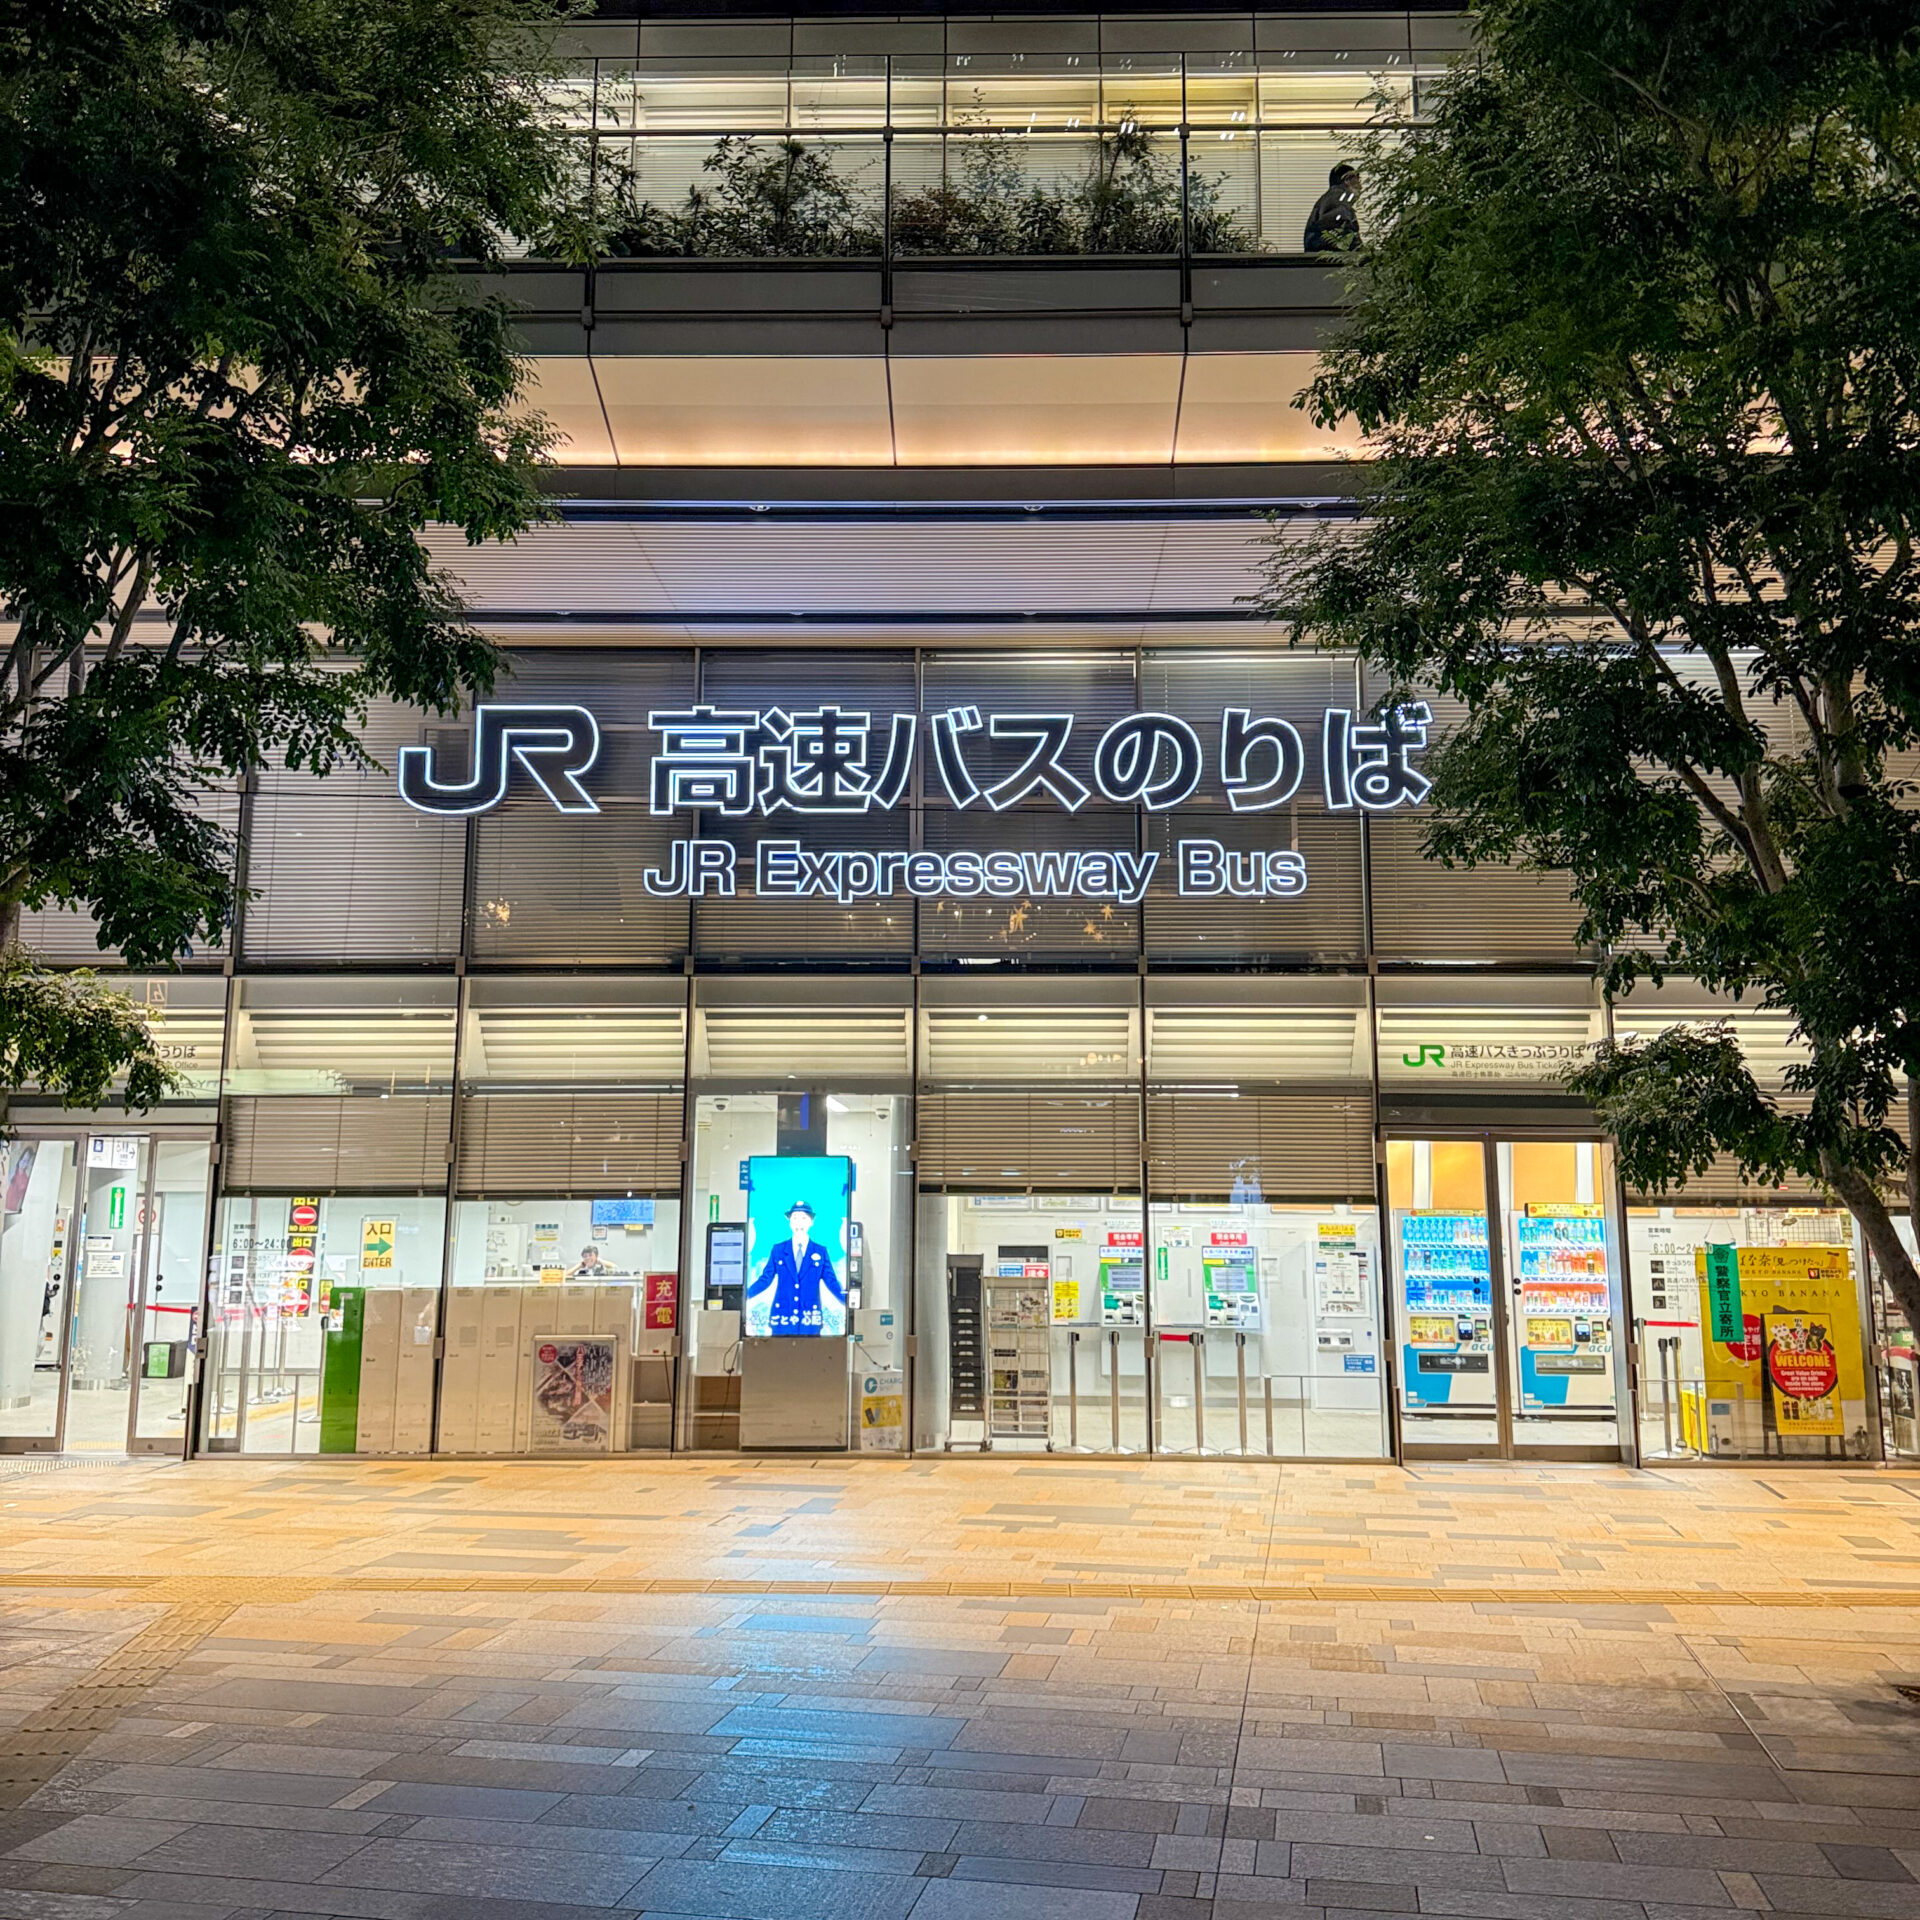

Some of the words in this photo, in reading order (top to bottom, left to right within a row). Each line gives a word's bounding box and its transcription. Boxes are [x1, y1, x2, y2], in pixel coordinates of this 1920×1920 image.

[398, 705, 602, 815] JR
[647, 701, 1434, 812] 高速バスのりば
[643, 840, 735, 896] JR
[757, 840, 1159, 904] Expressway
[1178, 840, 1308, 896] Bus
[160, 1046, 197, 1059] うりば
[1402, 1045, 1445, 1067] JR
[1450, 1045, 1585, 1059] 高速バスきっぷうりば
[174, 1061, 199, 1069] Office
[1450, 1061, 1463, 1069] JR
[1465, 1061, 1515, 1070] Expressway
[1518, 1061, 1533, 1069] Bus
[1537, 1061, 1563, 1069] Ticke
[366, 1223, 392, 1236] 入口
[292, 1238, 313, 1248] 出口
[363, 1257, 392, 1268] ENTER
[1741, 1289, 1769, 1297] KYO
[1779, 1289, 1841, 1297] BANANA
[655, 1279, 673, 1325] 充電
[1715, 1265, 1735, 1338] 警察官立寄所
[1471, 1342, 1495, 1352] acu
[1588, 1343, 1612, 1353] acu
[1775, 1355, 1831, 1368] WELCOME
